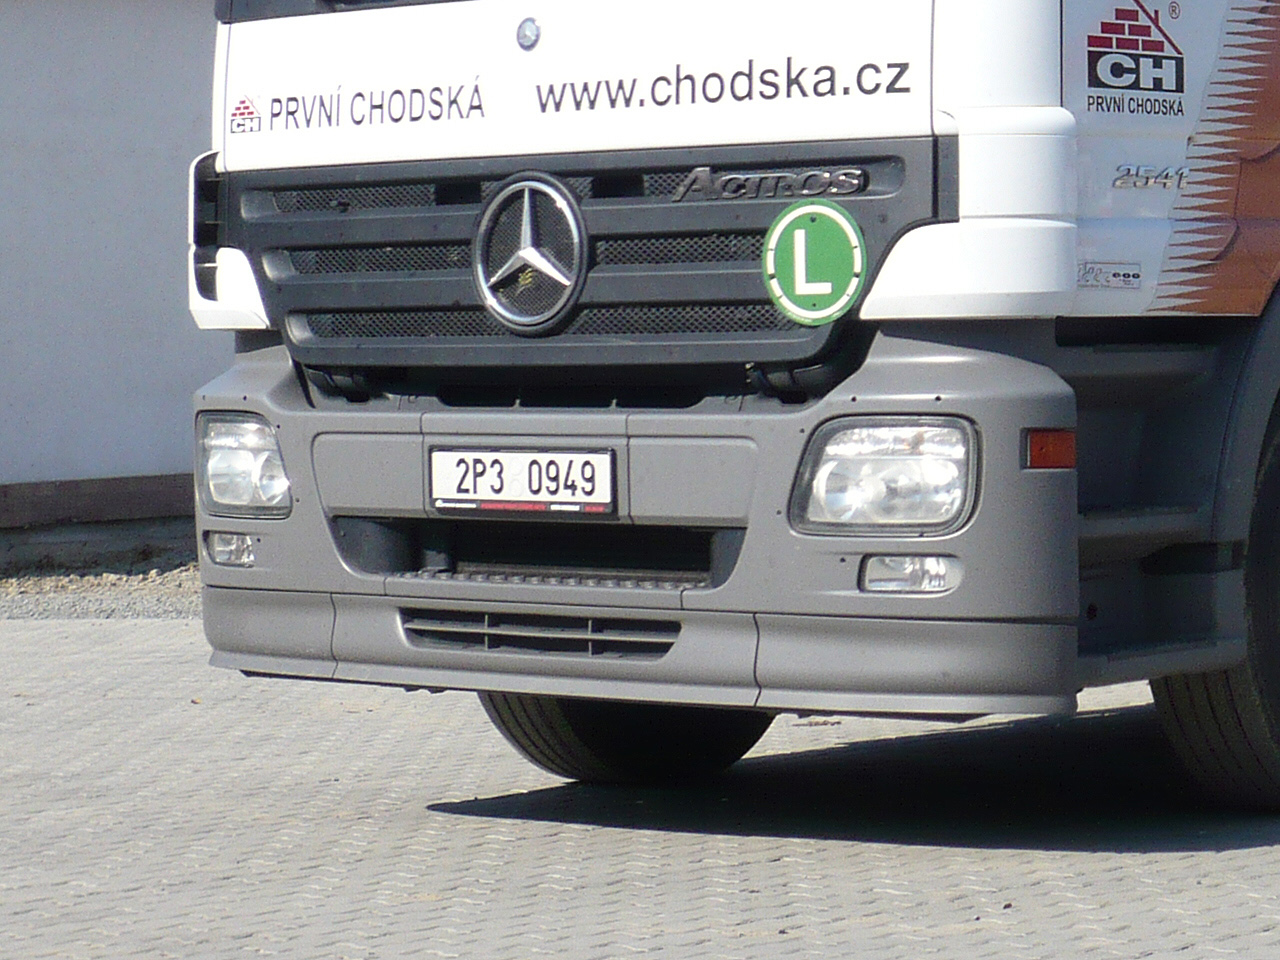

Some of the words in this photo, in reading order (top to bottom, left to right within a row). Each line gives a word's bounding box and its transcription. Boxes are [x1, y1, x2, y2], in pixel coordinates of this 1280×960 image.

[535, 56, 911, 114] www.chodska.cz
[1096, 53, 1177, 91] CH
[269, 85, 342, 131] PRVNÍ
[350, 74, 485, 126] CHODSKÁ
[1087, 93, 1125, 114] PRVNÍ
[1127, 95, 1185, 117] CHODSKÁ
[671, 166, 869, 203] Actros
[793, 228, 833, 296] L
[455, 457, 505, 495] 2P3
[527, 459, 597, 497] 0949
